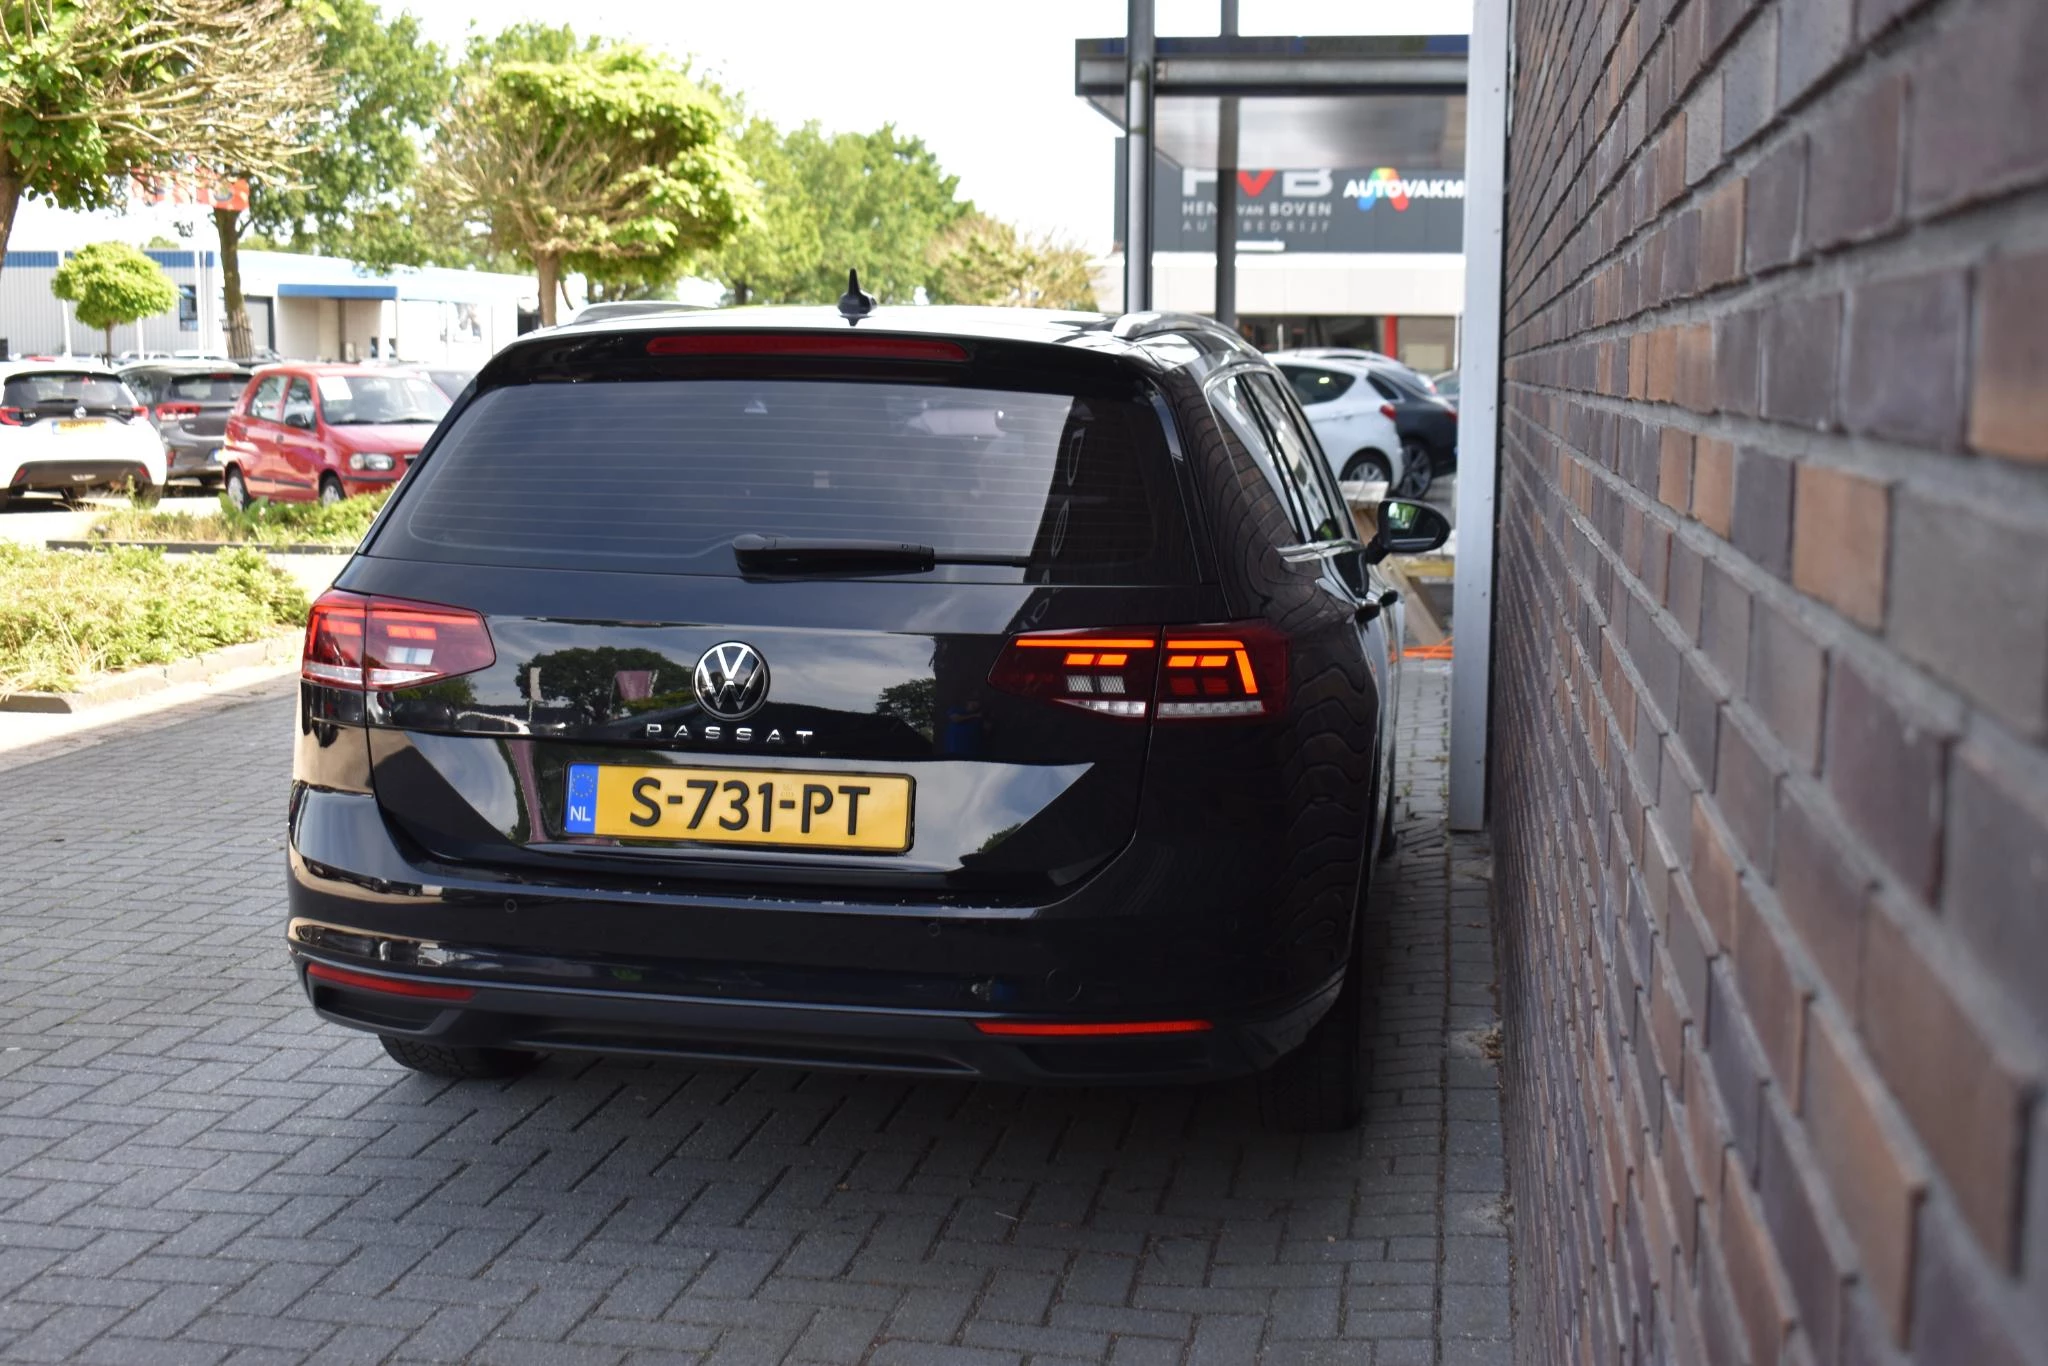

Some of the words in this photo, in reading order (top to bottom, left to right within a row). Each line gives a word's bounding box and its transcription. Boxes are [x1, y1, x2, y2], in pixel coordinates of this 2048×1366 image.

[1269, 201, 1331, 217] BOVEN
[646, 723, 814, 745] PASSAT
[570, 805, 592, 823] NL
[629, 776, 871, 836] S-731-PT
